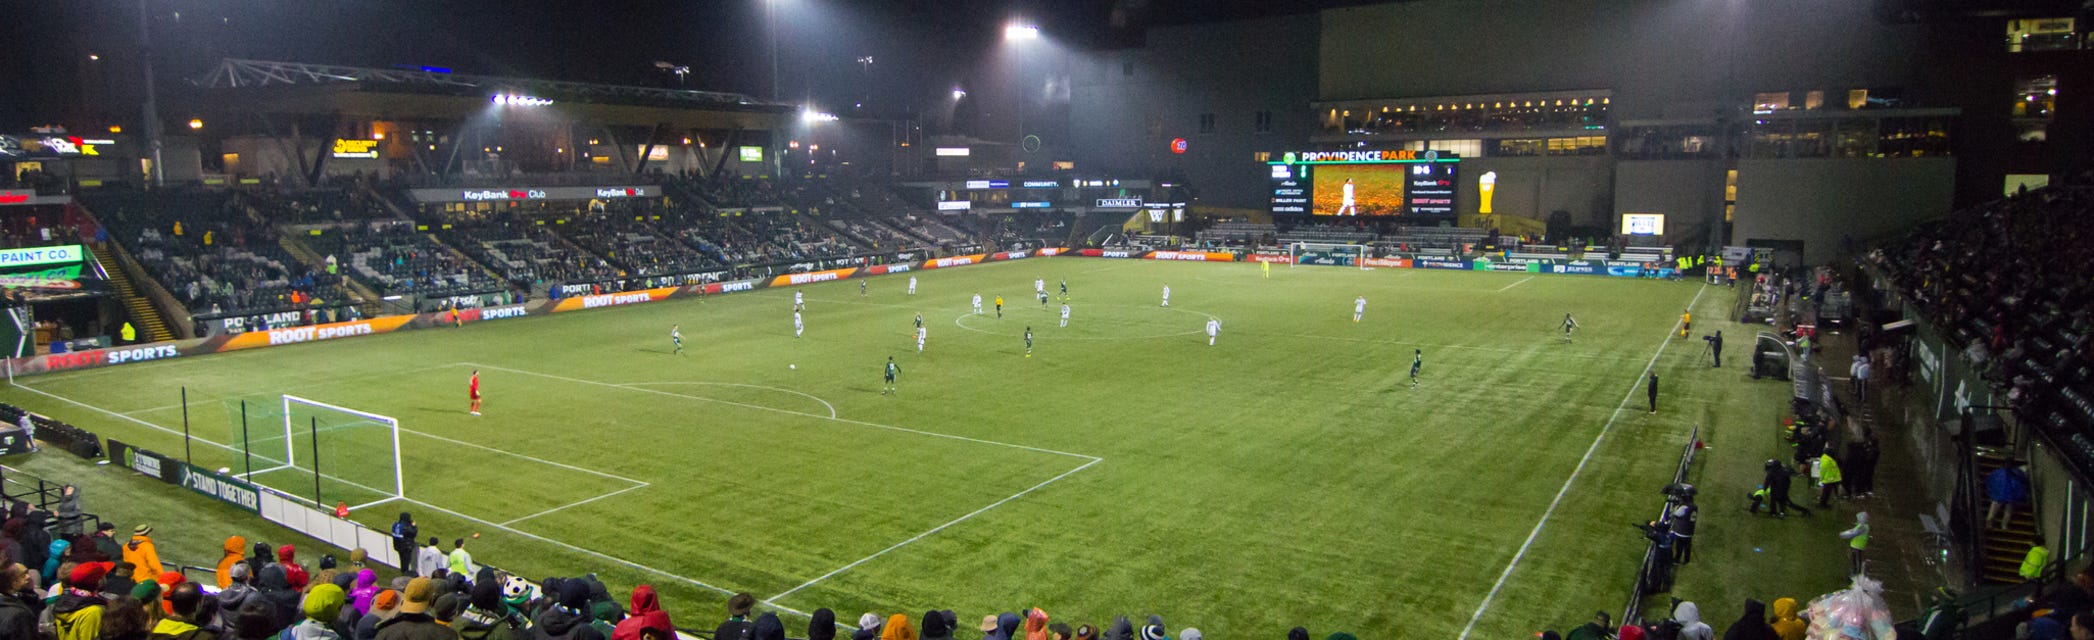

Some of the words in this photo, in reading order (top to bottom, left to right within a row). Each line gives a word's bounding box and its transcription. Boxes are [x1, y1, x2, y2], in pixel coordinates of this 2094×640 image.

[1302, 151, 1381, 162] PROVIDENCE
[1382, 150, 1416, 160] PARK
[463, 190, 509, 200] KeyBank
[528, 189, 546, 199] Club
[597, 188, 627, 198] KeyBank
[1102, 199, 1137, 207] DAIMLER
[1, 251, 43, 263] PAINT
[49, 249, 72, 261] CO.
[1155, 250, 1177, 259] ROOT
[790, 273, 812, 284] ROOT
[812, 272, 838, 281] SPORTS
[723, 281, 752, 294] SPORTS
[584, 294, 613, 308] ROOT
[614, 292, 650, 304] SPORTS
[482, 306, 526, 320] SPORTS
[269, 327, 315, 346] ROOT
[317, 323, 372, 340] SPORTS
[46, 350, 106, 370] ROOT
[107, 344, 177, 364] SPORTS
[192, 471, 217, 496] STAND
[216, 479, 258, 511] TOGETHER
